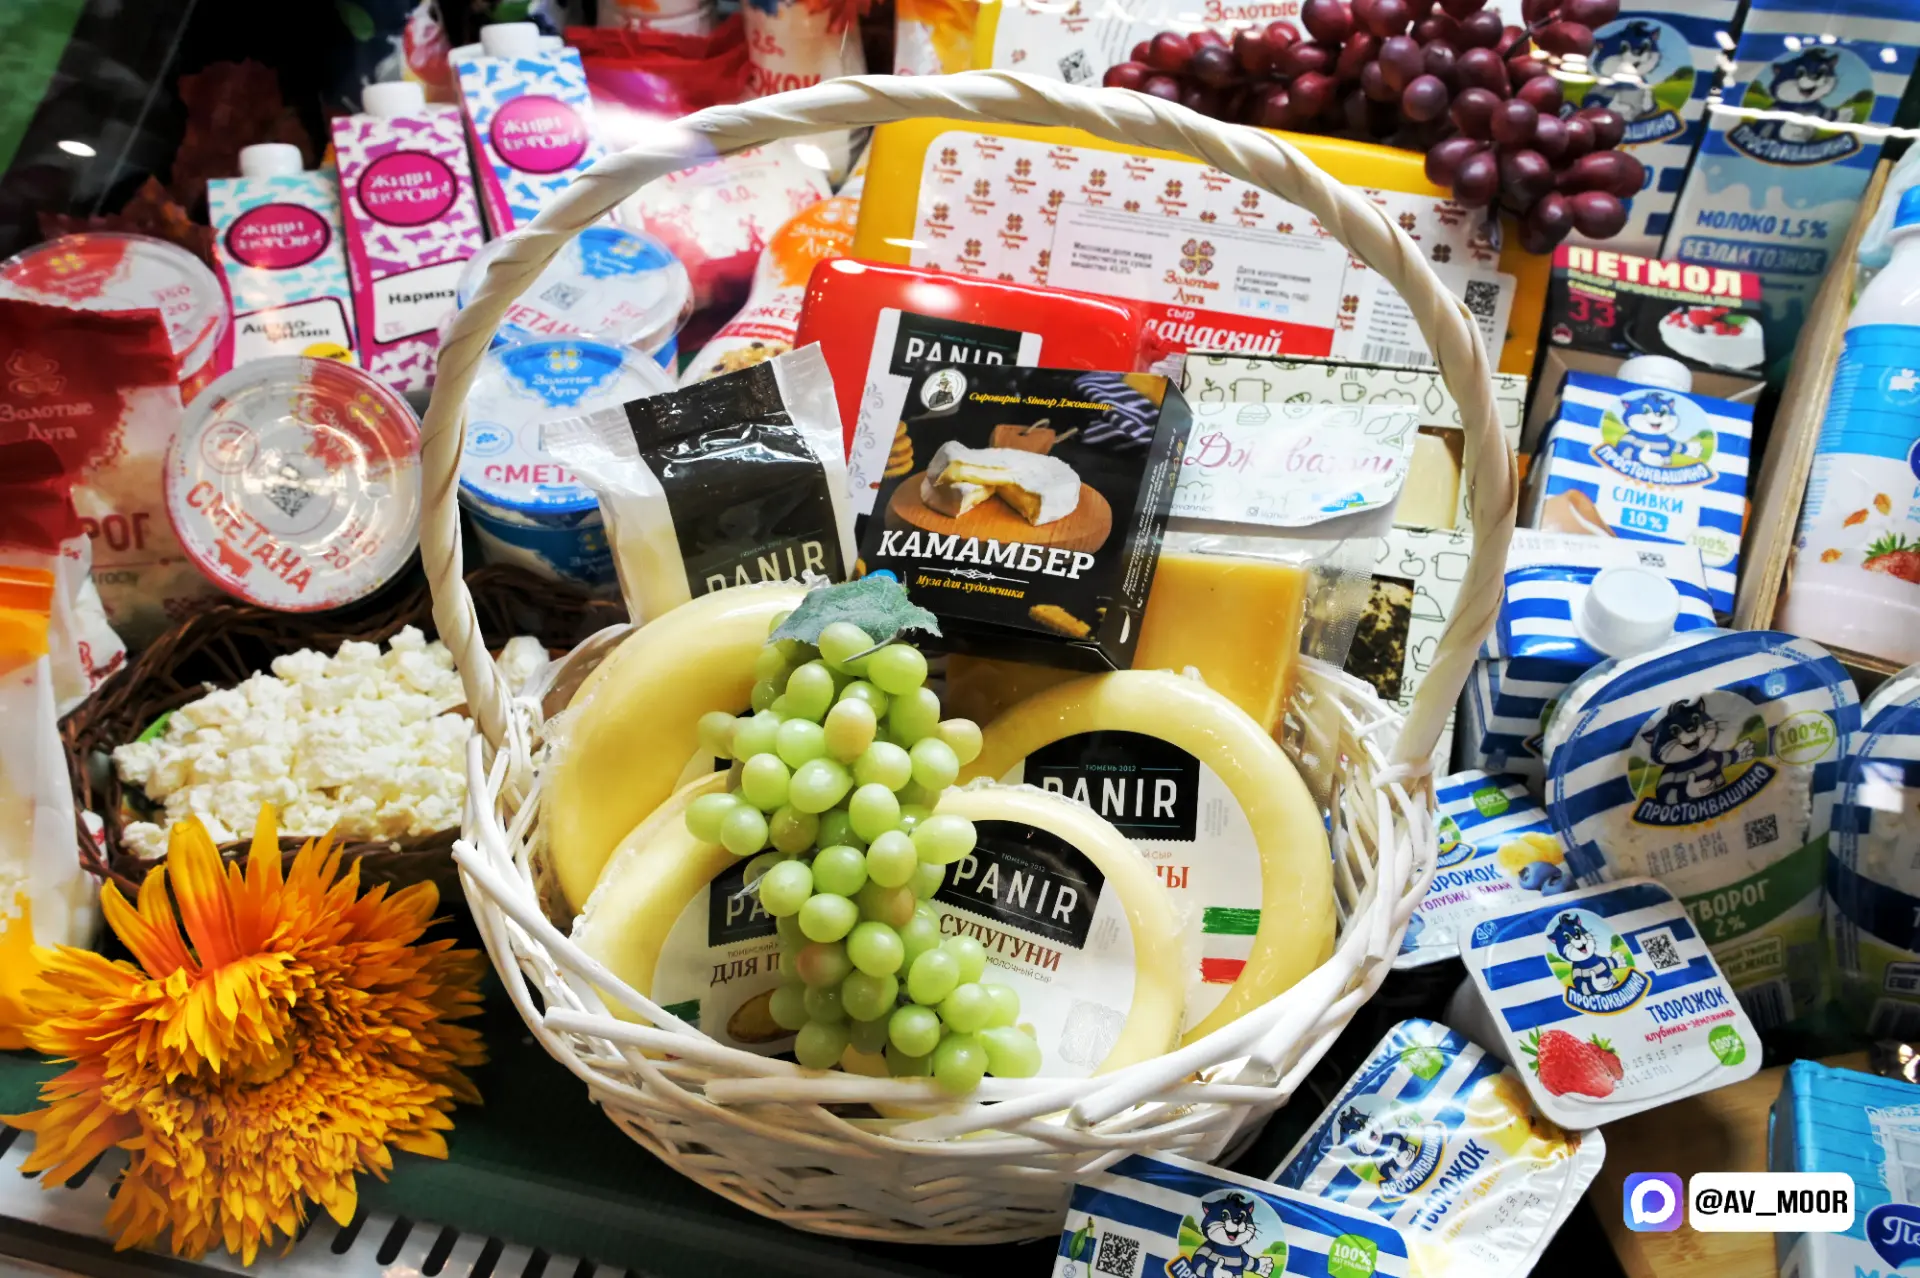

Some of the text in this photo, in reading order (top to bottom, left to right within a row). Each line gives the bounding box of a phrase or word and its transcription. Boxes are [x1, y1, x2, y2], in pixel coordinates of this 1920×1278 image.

[1204, 0, 1298, 22] Золотые
[1624, 114, 1677, 141] АШИНО
[1697, 209, 1776, 235] МОЛОКО
[1567, 245, 1742, 297] ПЕТМОЛ
[1681, 239, 1820, 272] БЕЗЛАКТОЗНОЕ
[1163, 269, 1221, 291] Золотые
[1173, 286, 1206, 306] Луга
[1166, 307, 1196, 322] сыр
[27, 422, 79, 440] Луга
[1612, 486, 1684, 515] СЛИВКИ
[185, 480, 314, 595] СМЕТАНА
[876, 529, 1096, 580] КАМАМБЕР
[916, 574, 1025, 600] Муза для художника
[1084, 764, 1137, 773] ТЮМЕНЬ 2012
[1042, 777, 1178, 818] PANIR
[1639, 764, 1770, 823] ПРОСТОКВАШИНО
[1001, 853, 1046, 874] ТЮМЕНЬ 2012
[952, 854, 1079, 925] PANIR
[1686, 878, 1771, 923] ТВОРОГ
[939, 913, 1063, 973] СУЛУГУНИ
[710, 956, 759, 988] ДЛЯ
[1568, 971, 1646, 1012] ПРОСТОКВАШИНО
[1645, 985, 1730, 1025] ТВОРОЖОК
[1408, 1138, 1491, 1232] ТВОРОЖОК
[1332, 1242, 1373, 1268] 100%
